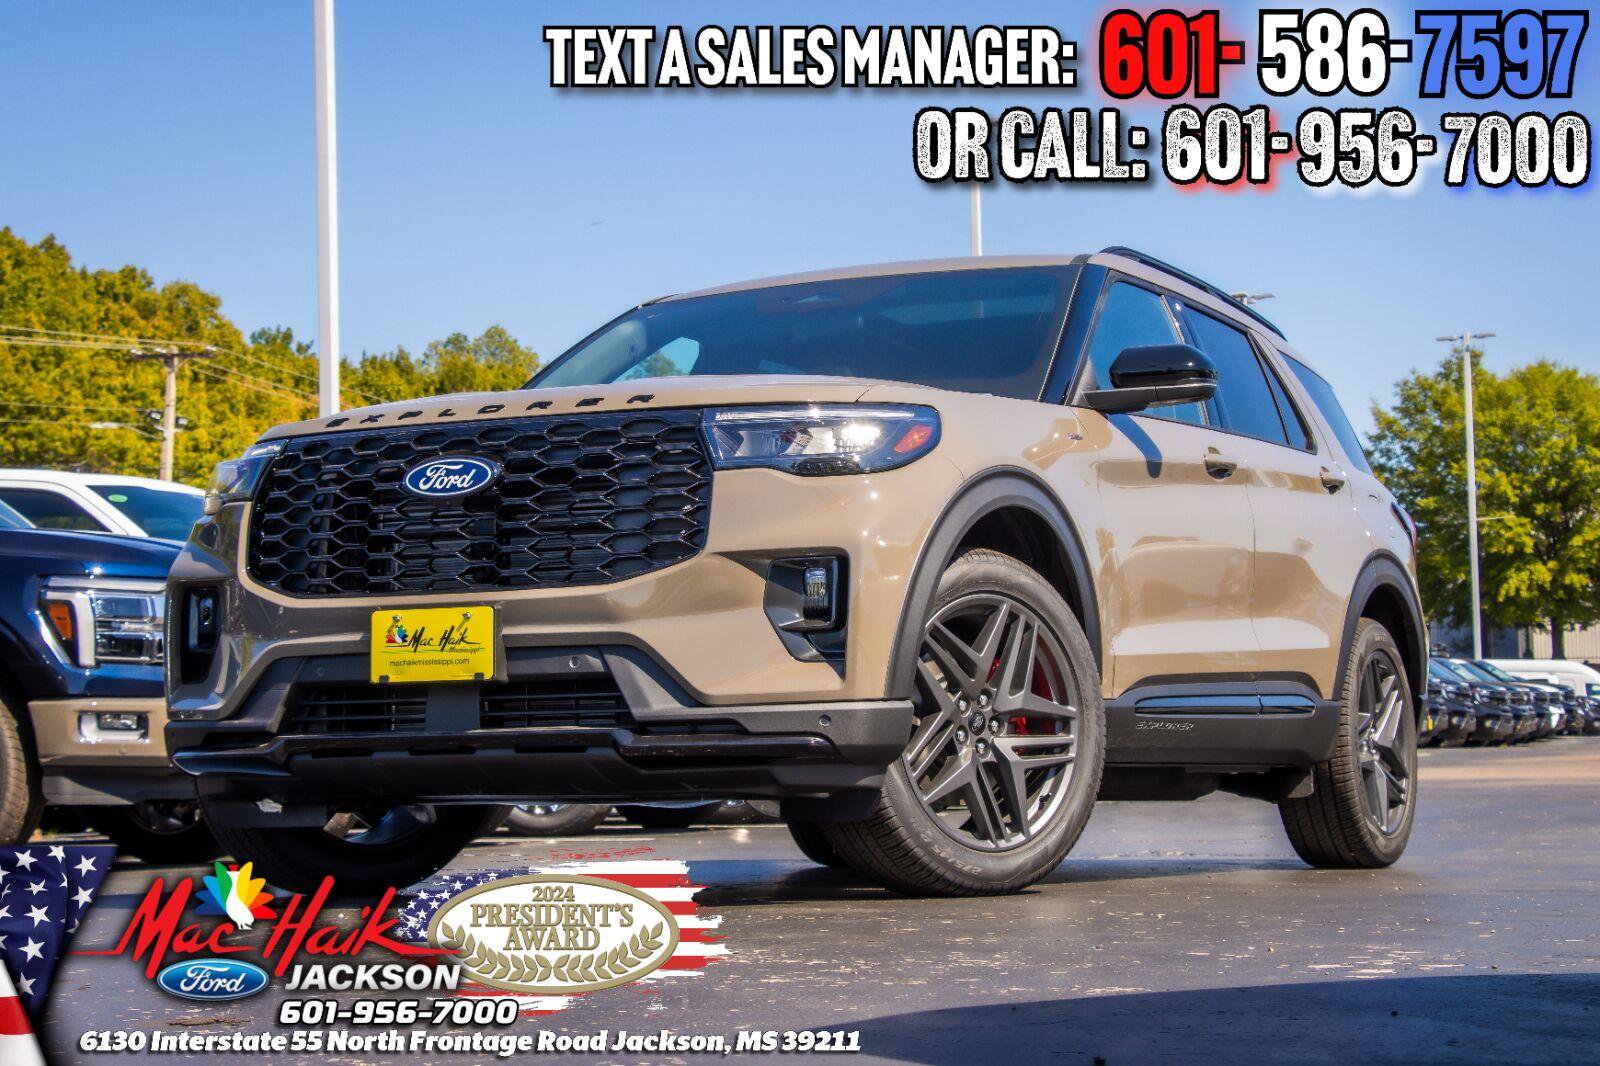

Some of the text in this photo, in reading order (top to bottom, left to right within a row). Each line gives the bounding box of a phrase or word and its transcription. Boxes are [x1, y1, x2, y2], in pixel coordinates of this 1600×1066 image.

[325, 394, 655, 428] EXPLORER
[418, 463, 474, 490] Ford
[408, 625, 481, 653] Mac Haik
[389, 657, 470, 667] machaikmississippi.com
